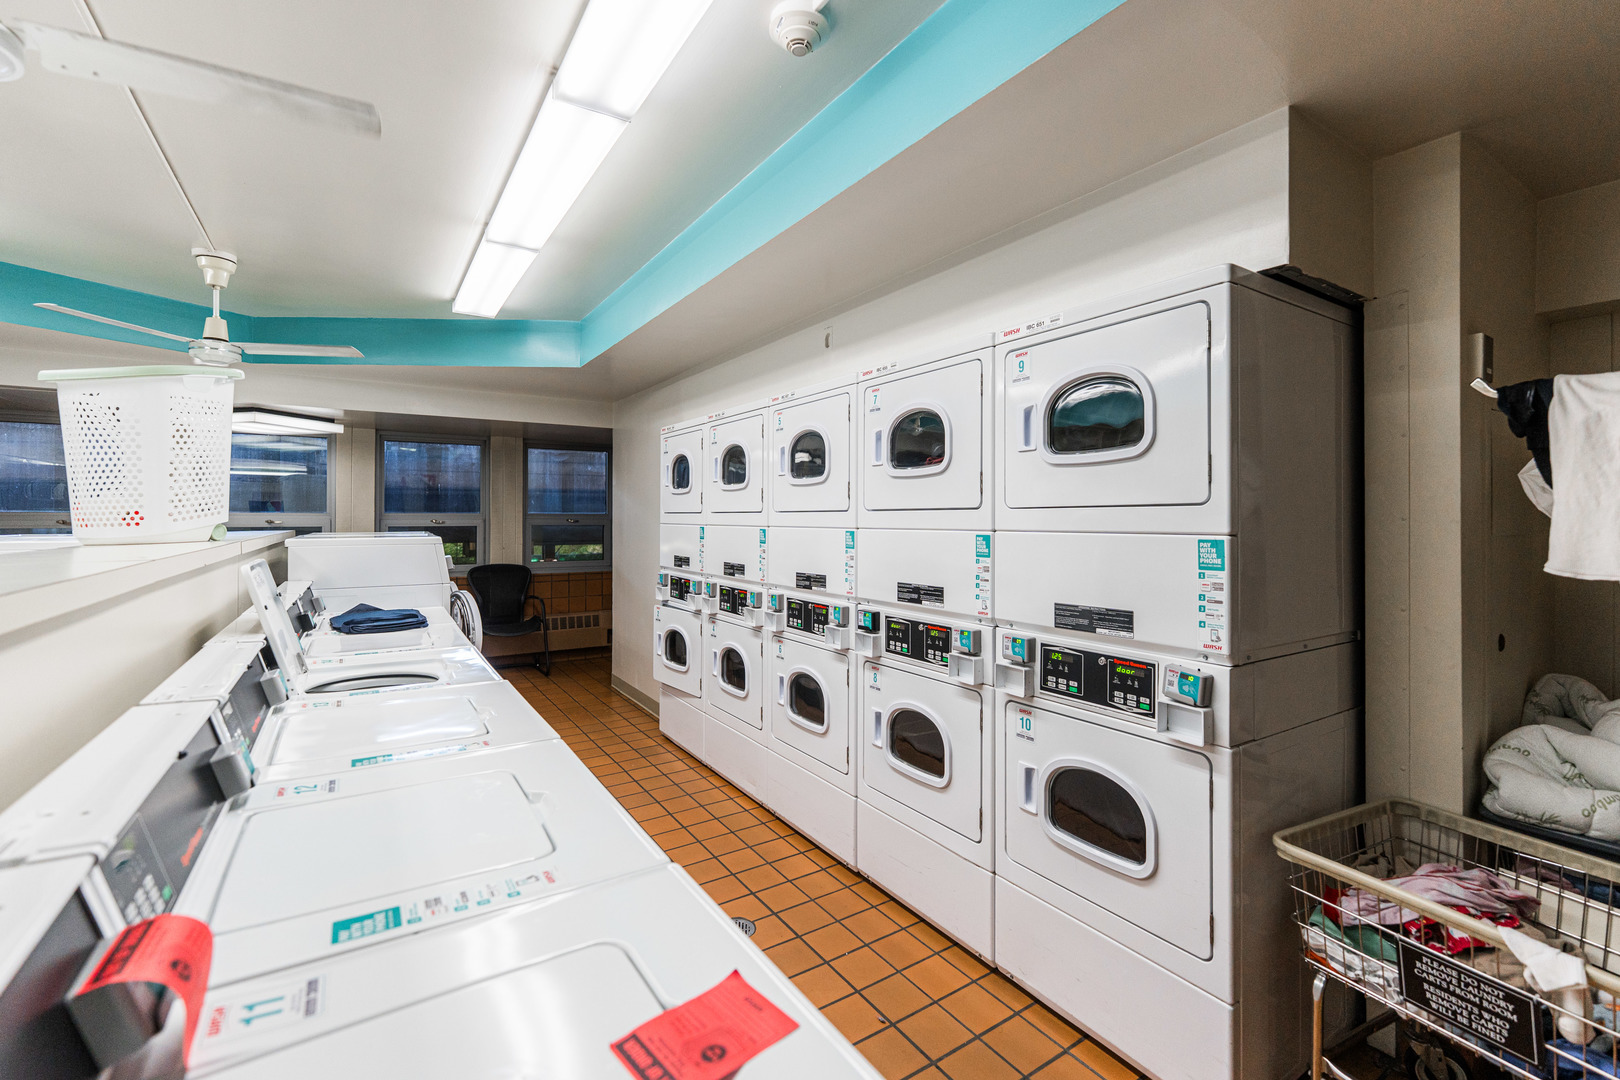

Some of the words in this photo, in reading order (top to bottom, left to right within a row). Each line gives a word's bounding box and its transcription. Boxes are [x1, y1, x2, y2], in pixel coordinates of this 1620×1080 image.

[1018, 360, 1024, 373] 9
[873, 394, 878, 405] 7
[1113, 658, 1129, 666] Speed
[1116, 665, 1135, 675] door
[873, 672, 877, 683] 8
[1019, 716, 1032, 731] 10
[292, 783, 318, 795] 12
[1416, 960, 1458, 986] REMOVE
[1460, 982, 1515, 1012] LAUNDRY
[1422, 956, 1459, 978] PLEASE
[1460, 974, 1478, 986] DO
[1480, 983, 1506, 999] NOT
[1414, 968, 1448, 988] CARTS
[1449, 984, 1480, 1004] FROM
[1482, 1000, 1518, 1022] ROOM
[1423, 982, 1479, 1015] RESIDENTS
[1480, 1010, 1510, 1030] WHO
[238, 995, 285, 1027] 11
[1426, 991, 1469, 1018] REMOVE
[1471, 1015, 1508, 1037] CARTS
[1429, 1001, 1455, 1018] WILL
[1457, 1014, 1470, 1026] BE
[1472, 1022, 1506, 1044] FINED
